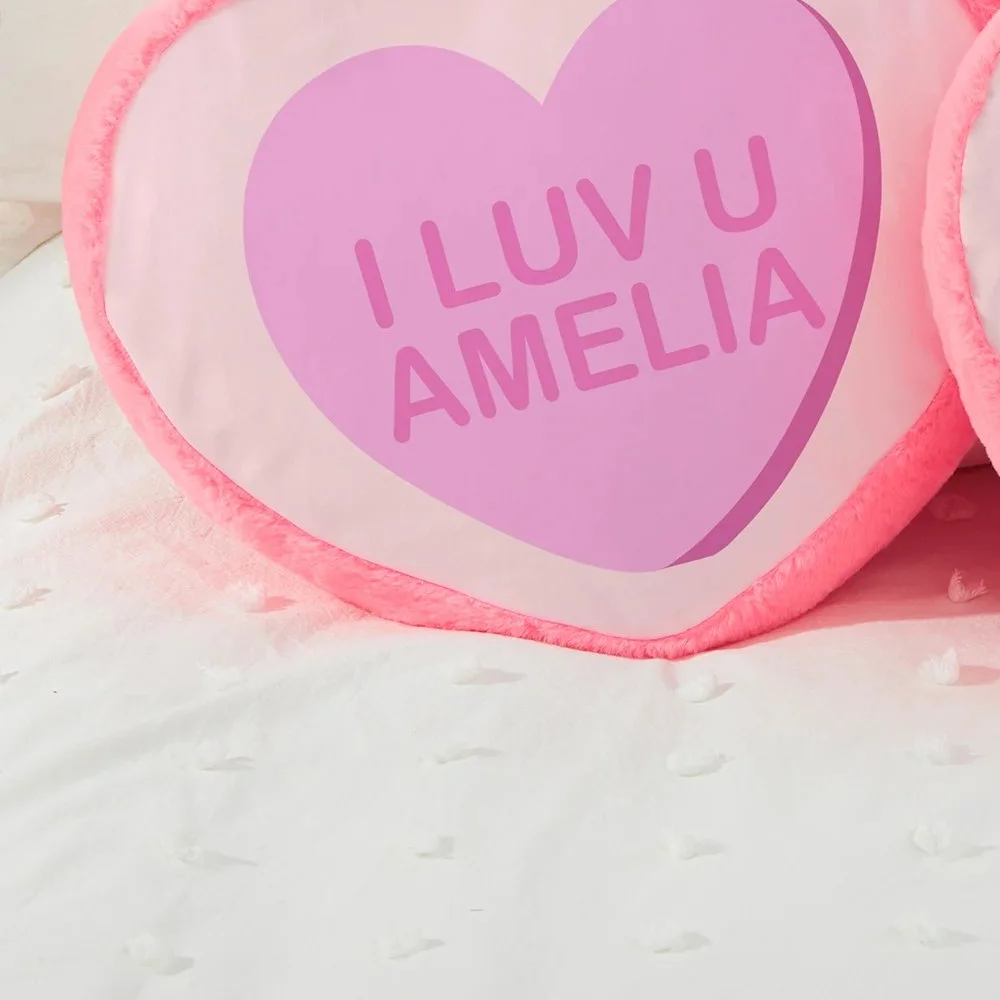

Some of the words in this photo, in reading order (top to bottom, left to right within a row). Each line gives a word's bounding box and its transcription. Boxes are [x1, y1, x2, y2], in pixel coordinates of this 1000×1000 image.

[354, 238, 395, 329] I
[419, 163, 652, 309] LUV
[693, 134, 778, 234] U
[392, 247, 827, 444] AMELIA
